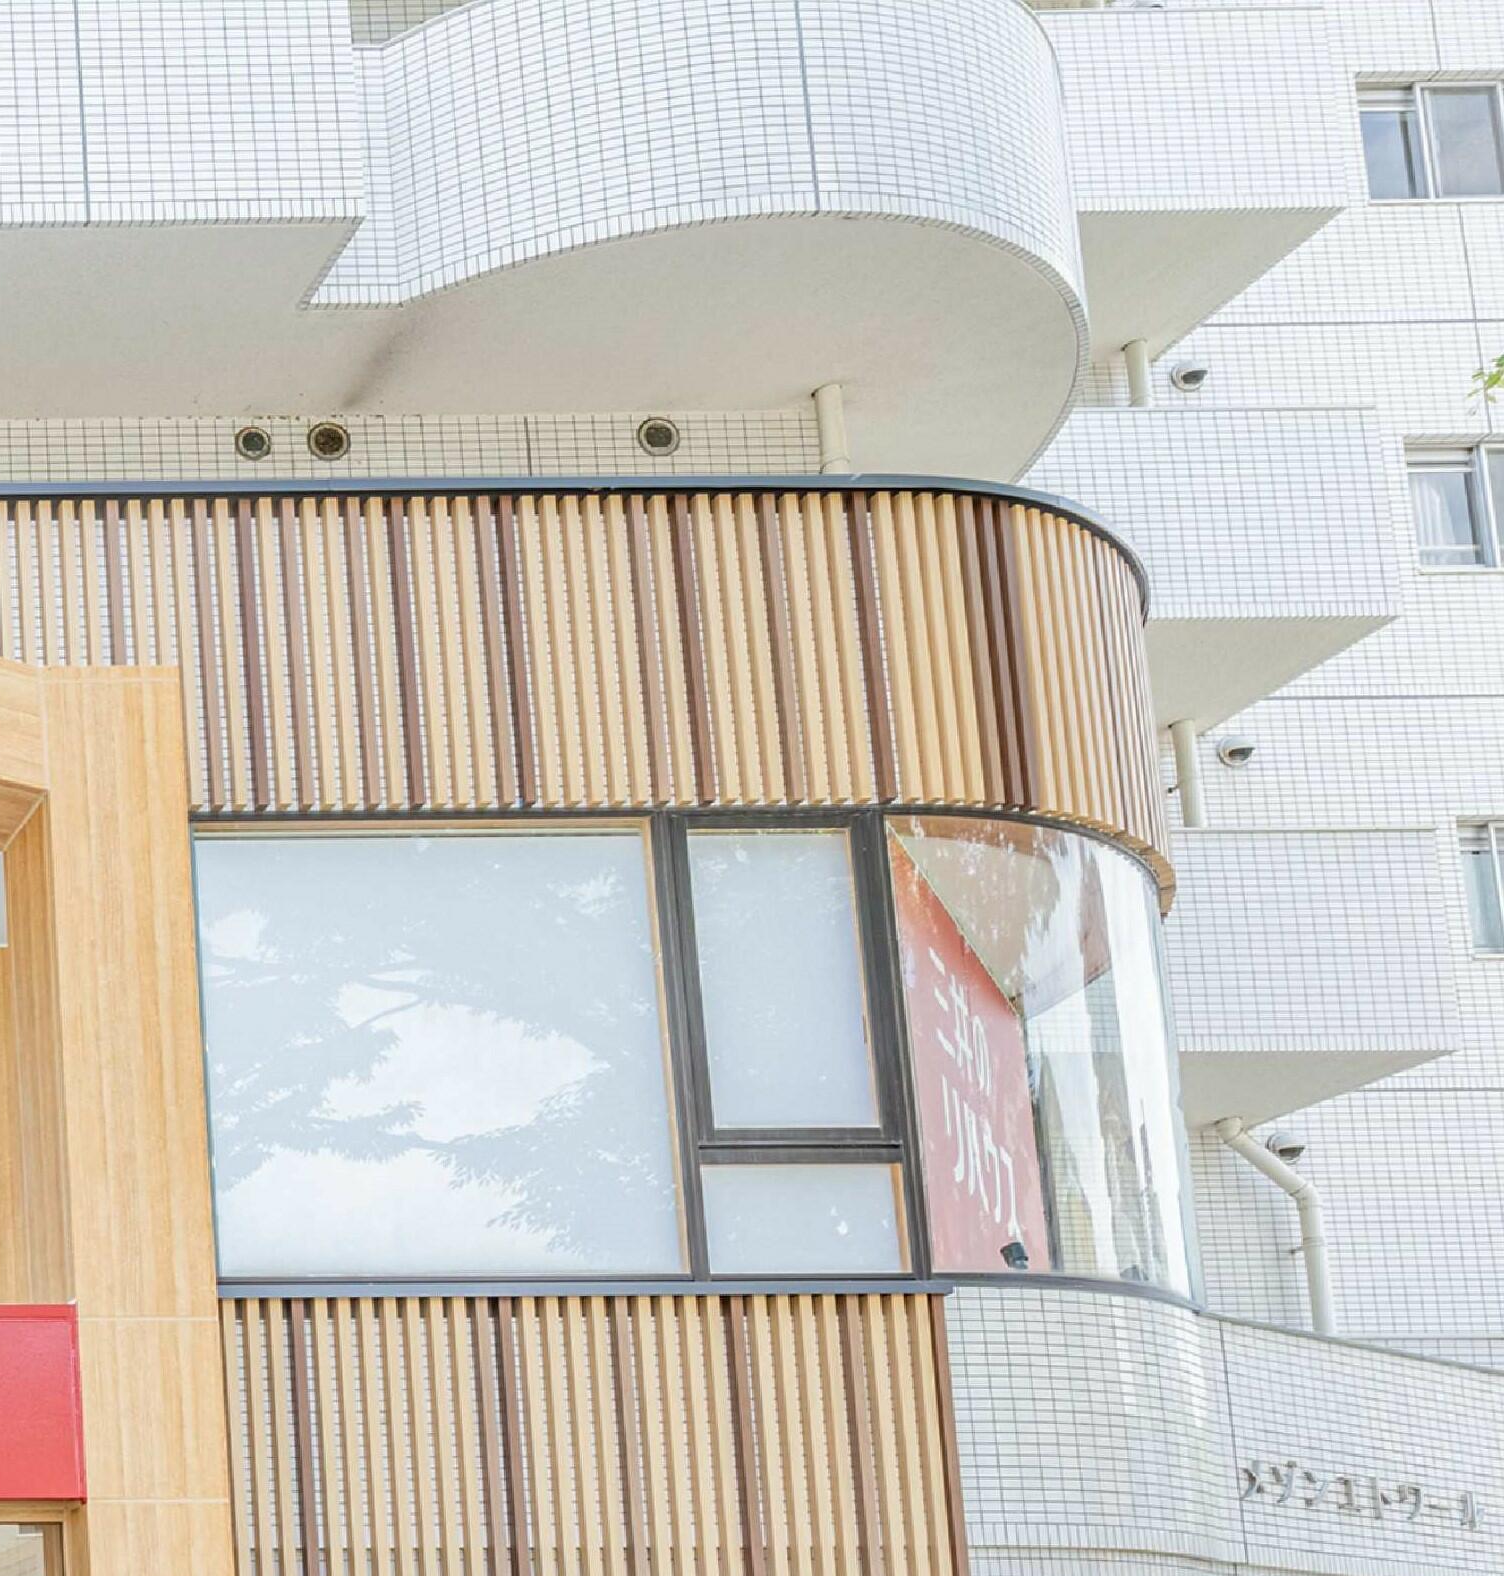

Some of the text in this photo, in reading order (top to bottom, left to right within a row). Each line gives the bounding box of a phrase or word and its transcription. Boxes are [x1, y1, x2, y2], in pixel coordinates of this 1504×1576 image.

[1240, 1460, 1486, 1531] メゾンエトワール
